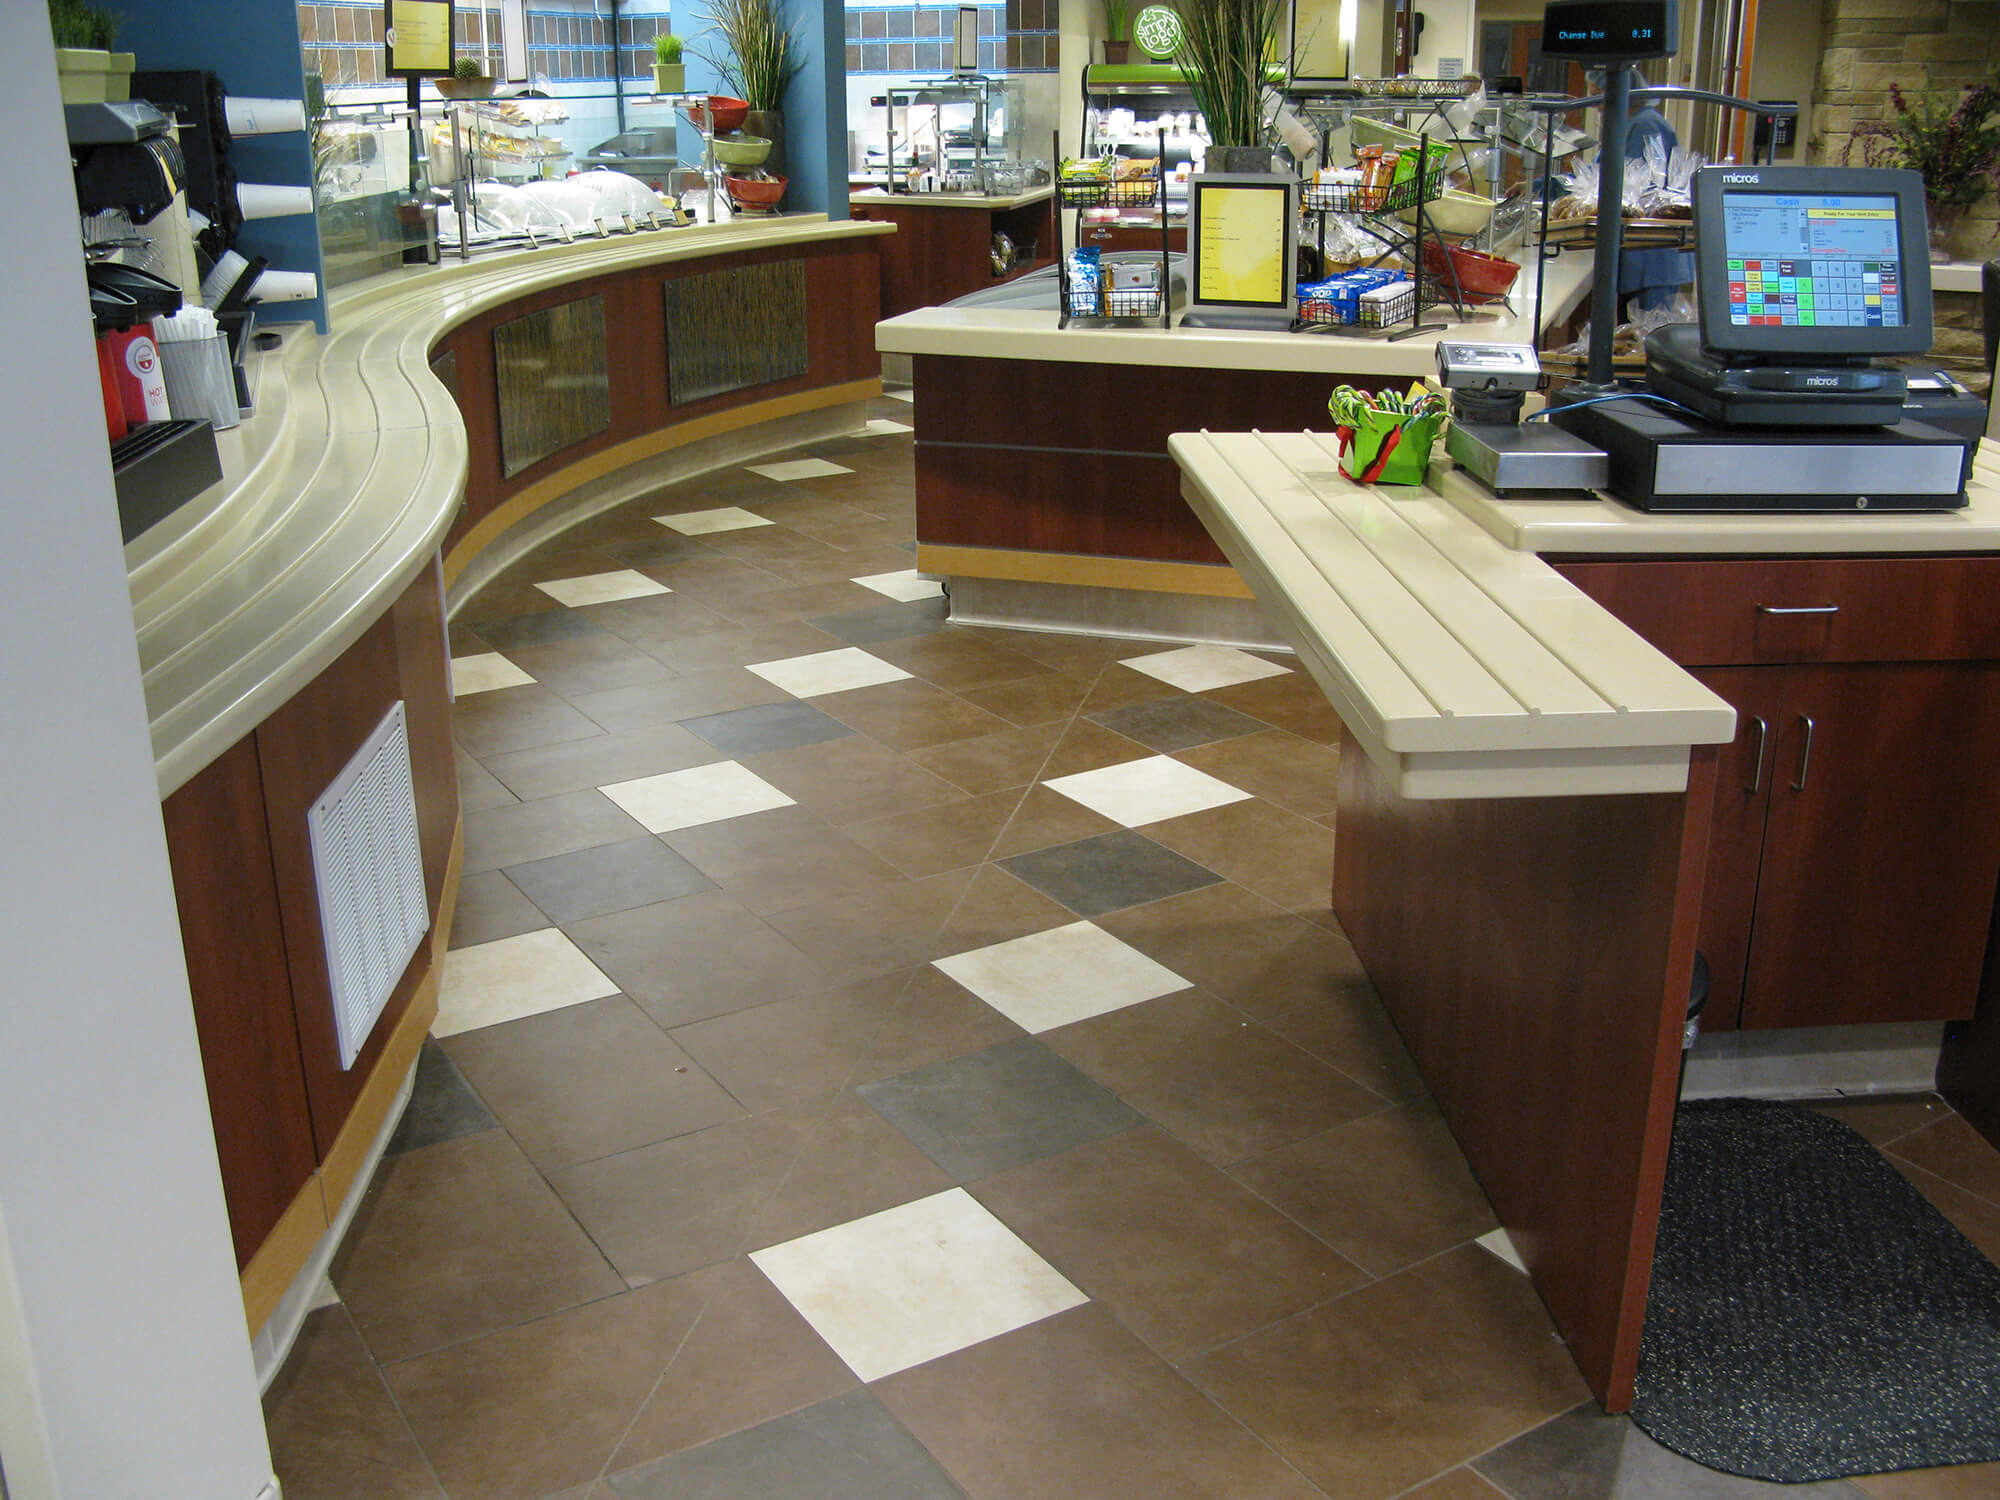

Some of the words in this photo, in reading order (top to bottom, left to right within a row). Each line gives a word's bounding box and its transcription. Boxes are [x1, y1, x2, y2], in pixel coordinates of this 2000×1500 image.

[1590, 30, 1606, 39] Due
[1631, 28, 1652, 39] 0.31
[1722, 172, 1760, 184] micros
[1806, 376, 1839, 386] micros
